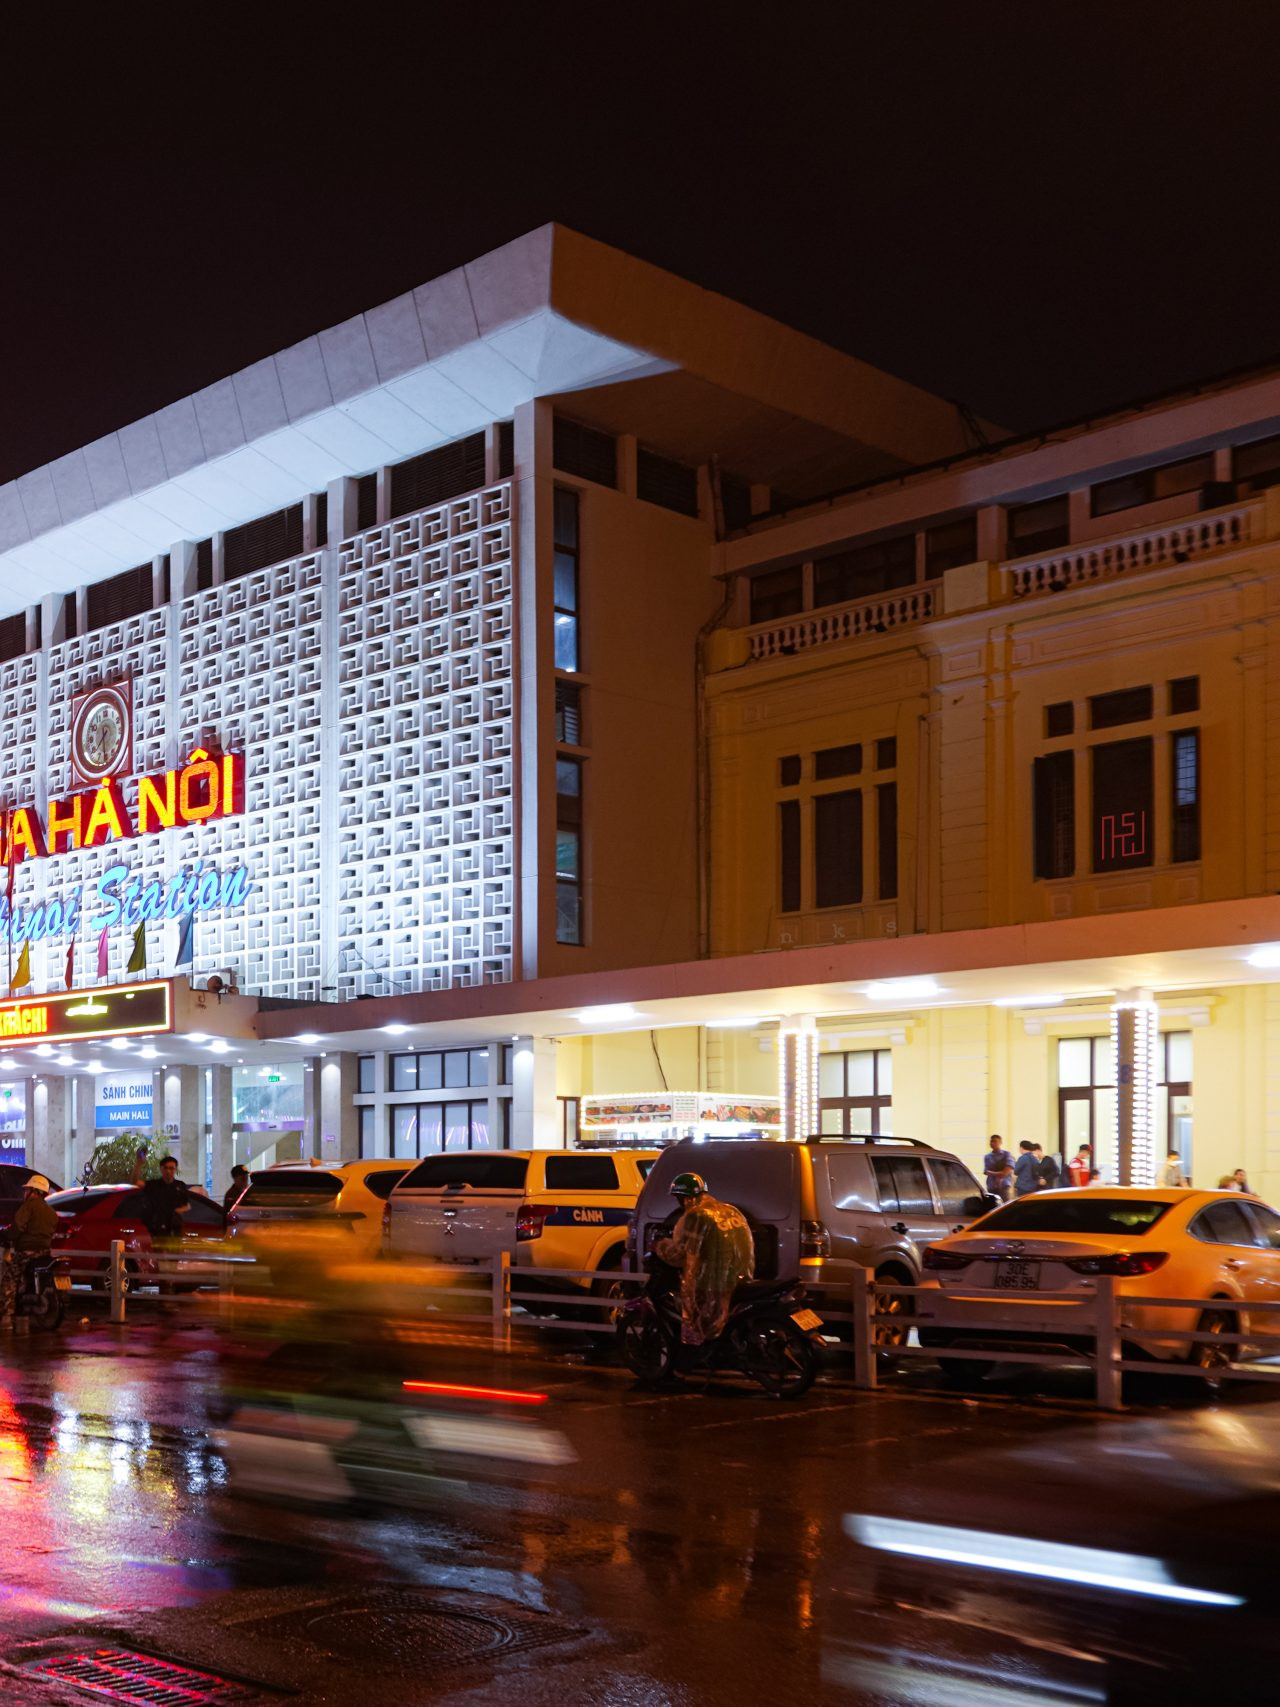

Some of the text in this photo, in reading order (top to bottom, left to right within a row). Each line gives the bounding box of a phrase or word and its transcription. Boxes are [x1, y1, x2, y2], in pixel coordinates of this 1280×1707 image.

[48, 777, 124, 854] HÀ
[137, 748, 235, 833] NỘI
[91, 859, 253, 930] Station
[109, 1110, 150, 1121] MAIN HALL
